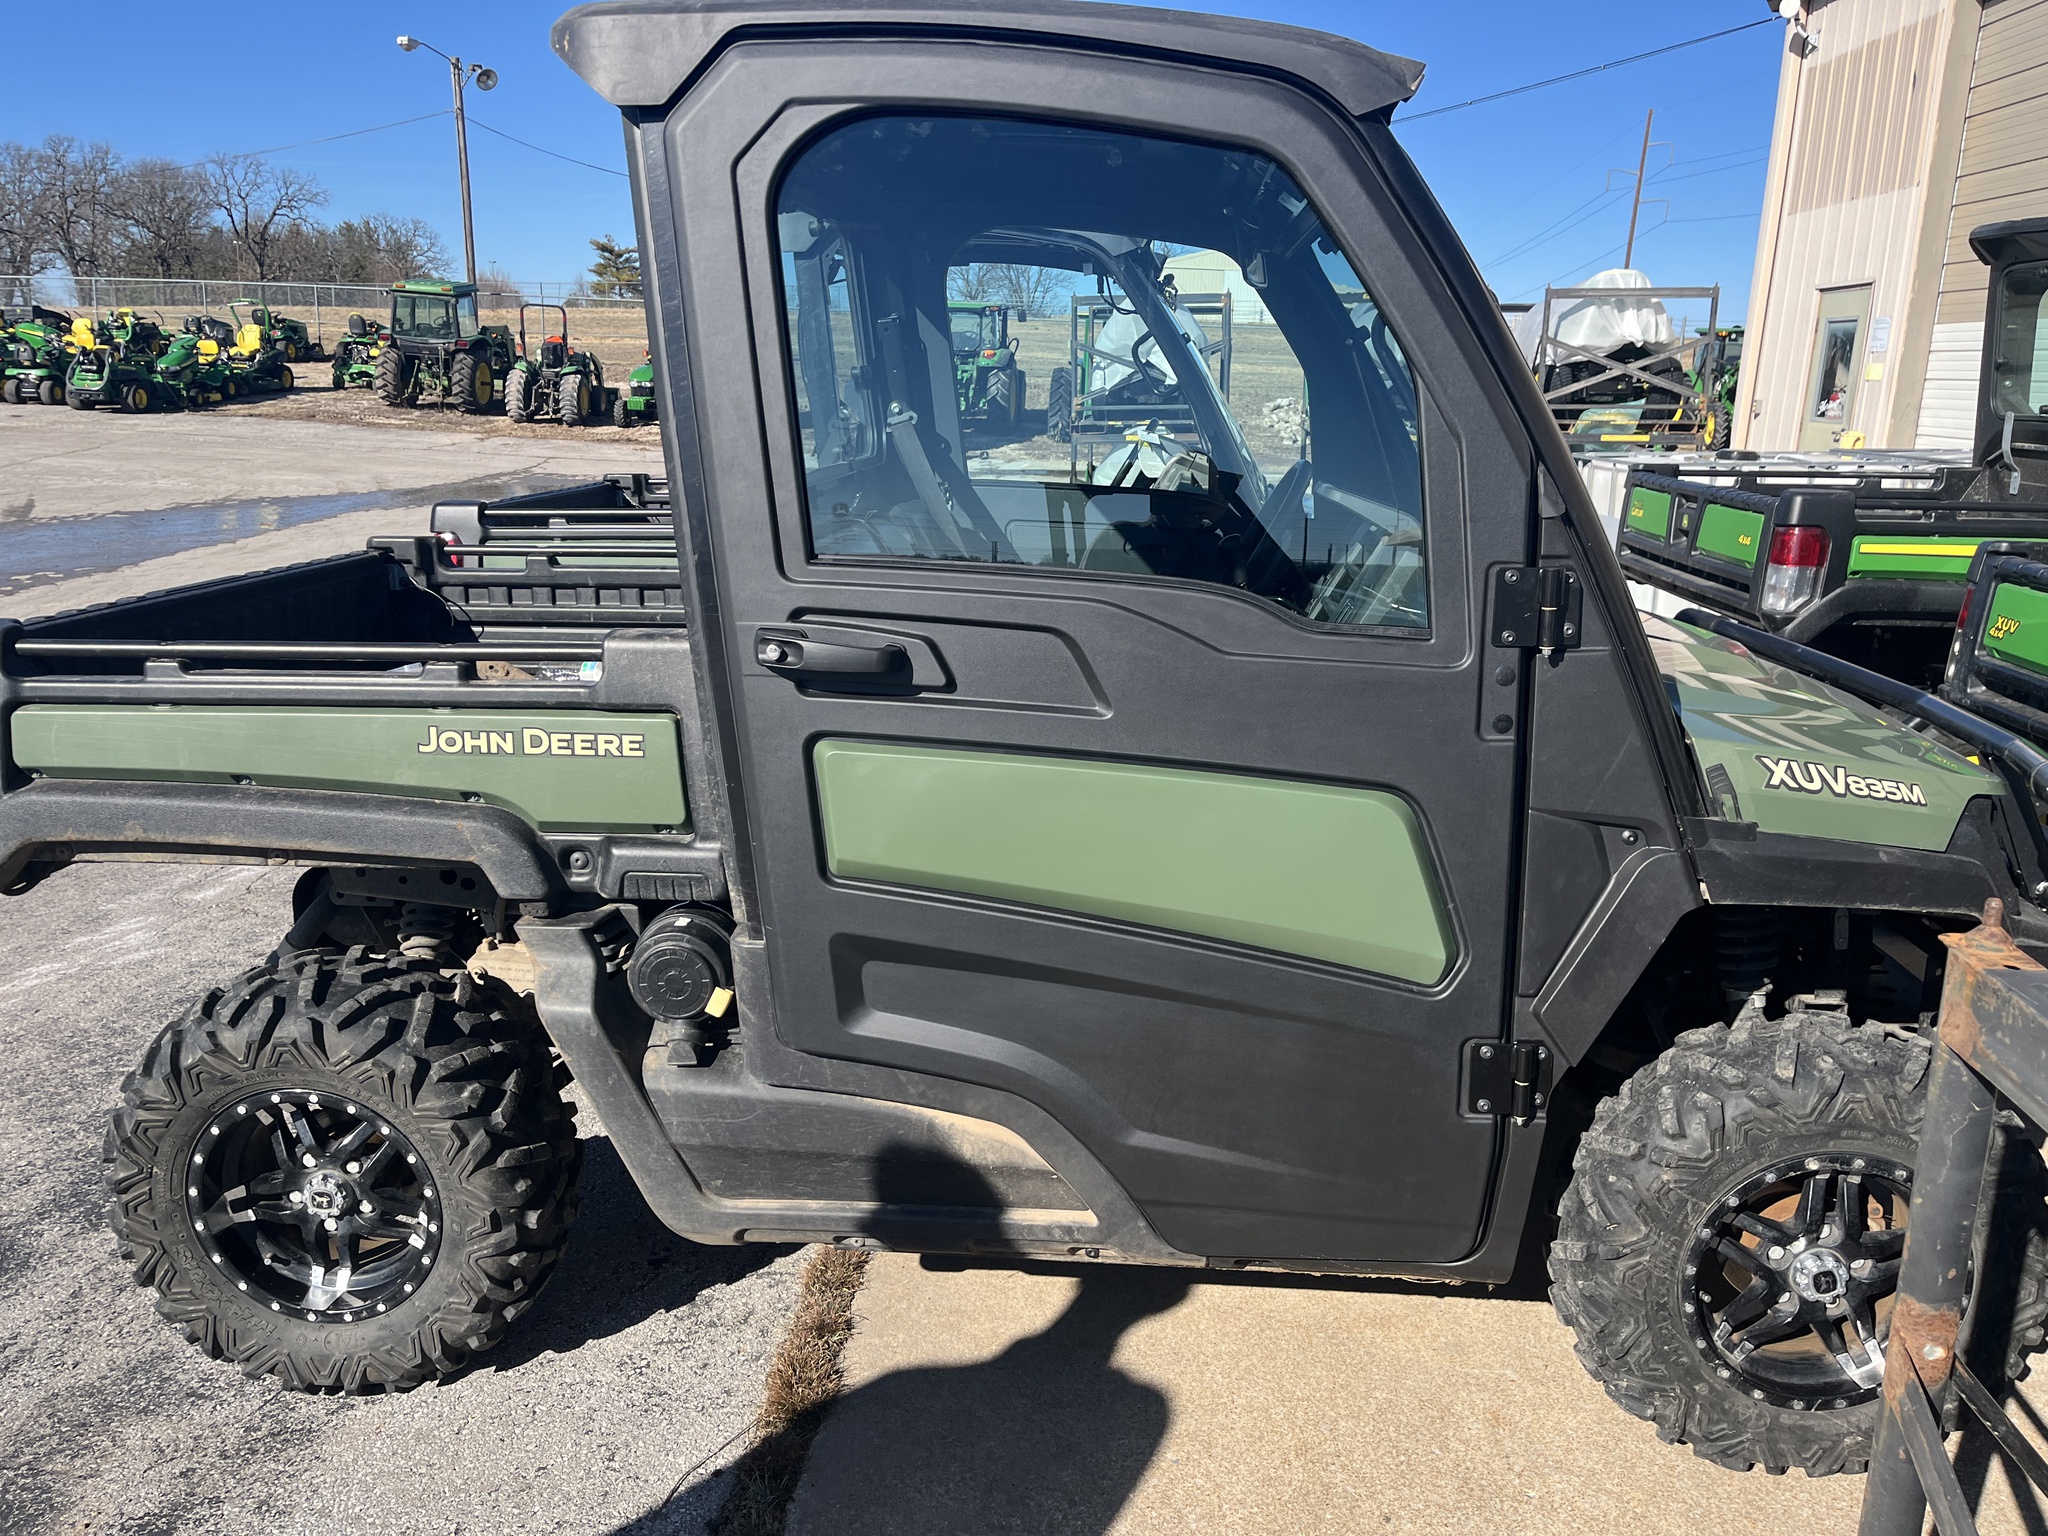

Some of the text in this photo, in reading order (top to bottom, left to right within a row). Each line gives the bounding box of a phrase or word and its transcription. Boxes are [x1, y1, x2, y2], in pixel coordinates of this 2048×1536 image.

[1995, 614, 2021, 635] XUV
[417, 724, 645, 758] JOHN DEERE
[1754, 754, 1929, 807] XUV835M
